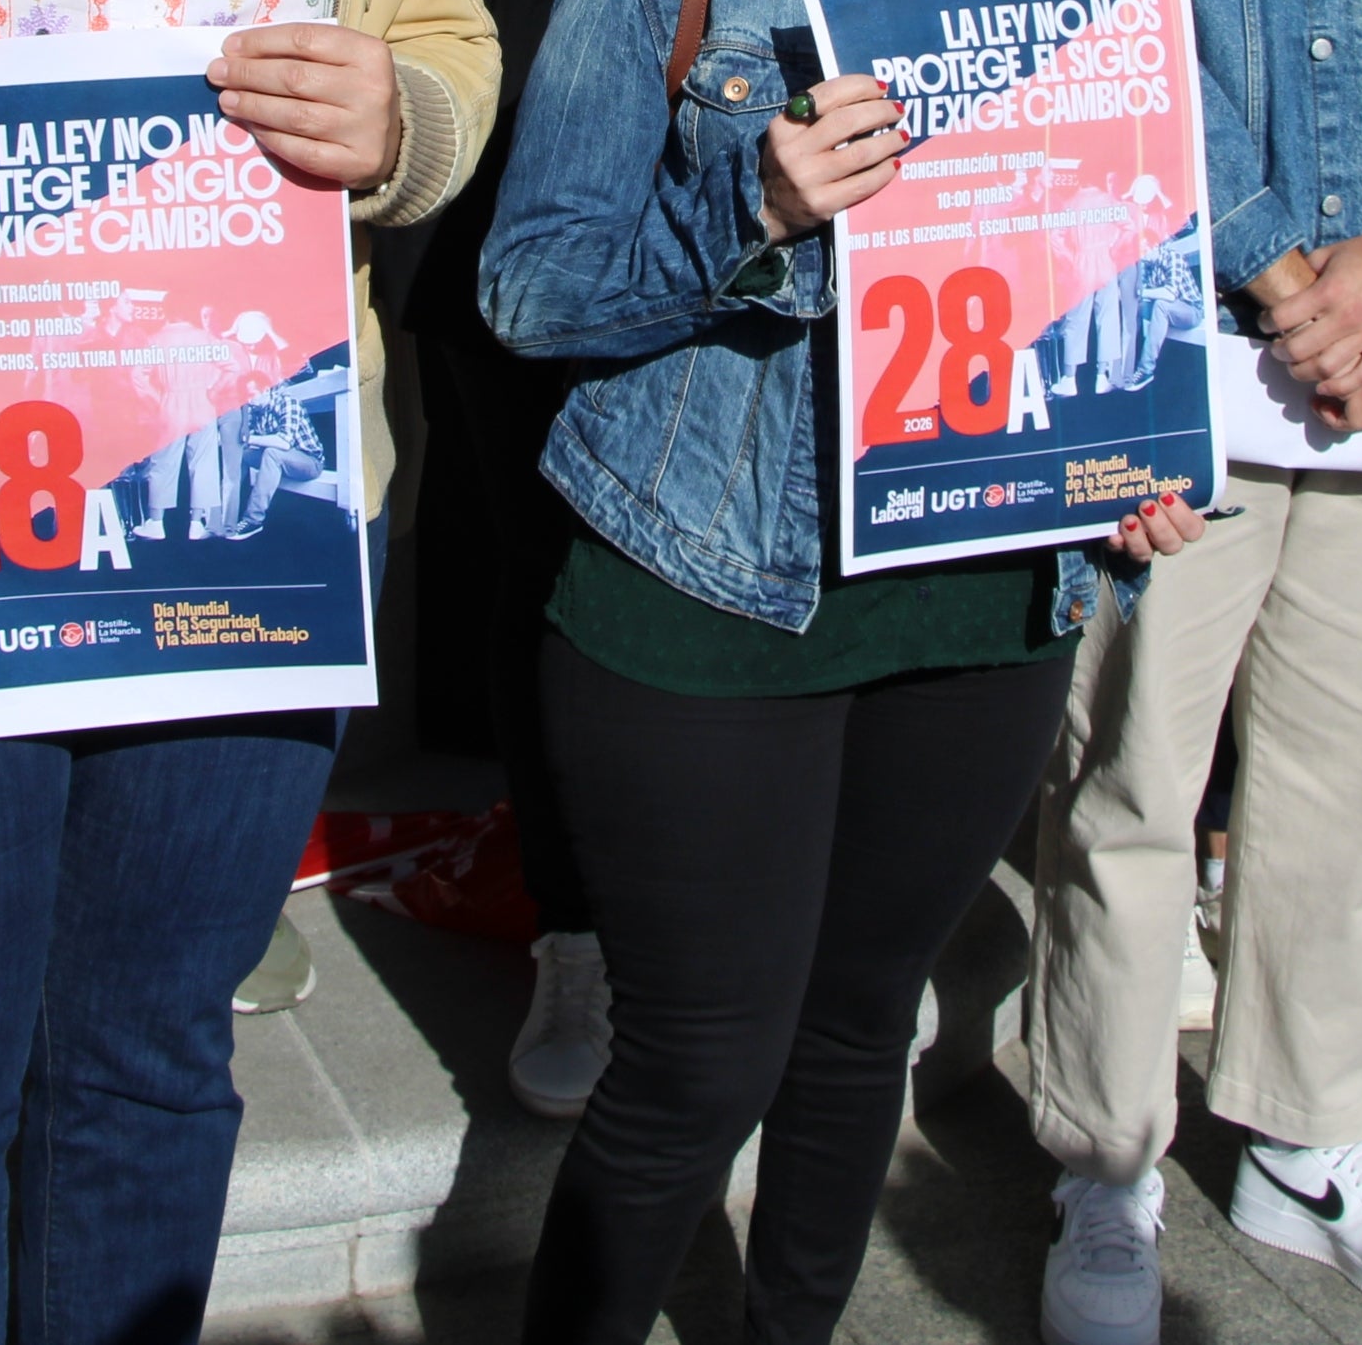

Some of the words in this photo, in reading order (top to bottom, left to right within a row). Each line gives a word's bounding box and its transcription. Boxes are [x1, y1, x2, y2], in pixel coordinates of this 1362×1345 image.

[940, 9, 979, 49] LA
[980, 4, 1028, 46] LEY
[1033, 0, 1087, 42] NO
[1034, 45, 1063, 83] EL
[1067, 35, 1166, 79] SIGLO
[883, 99, 922, 138] XI
[928, 90, 1019, 137] EXIGE
[1023, 75, 1171, 126] CAMBIOS
[47, 117, 106, 165] LEY
[113, 115, 183, 162] NO
[189, 113, 256, 154] NO
[901, 152, 1000, 181] CONCENTRACIÓN
[1002, 151, 1045, 170] TOLEDO
[106, 165, 146, 208] EL
[152, 157, 283, 204] SIGLO
[936, 189, 971, 210] 10:00
[974, 185, 1013, 207] HORAS
[91, 202, 285, 253] CAMBIOS
[849, 236, 870, 251] RNO
[873, 233, 887, 248] DE
[890, 230, 910, 247] LOS
[913, 223, 976, 244] BIZCOCHOS,
[979, 216, 1038, 236] ESCULTURA
[1041, 209, 1077, 231] MARÍA
[1080, 206, 1128, 225] PACHECO
[67, 280, 120, 302] TOLEDO
[35, 317, 83, 336] HORAS
[43, 350, 117, 370] ESCULTURA
[120, 344, 165, 367] MARÍA
[169, 344, 230, 364] PACHECO
[904, 417, 933, 433] 2026
[1066, 461, 1084, 477] Día
[1085, 455, 1128, 474] Mundial
[1066, 477, 1081, 491] de
[1083, 475, 1094, 489] la
[1095, 465, 1152, 488] Seguridad
[887, 486, 924, 508] Salud
[931, 487, 981, 513] UGT
[1027, 485, 1054, 496] Mancha
[1065, 494, 1073, 507] y
[1074, 490, 1085, 504] la
[1086, 484, 1118, 502] Salud
[1119, 485, 1135, 499] en
[1136, 481, 1148, 497] el
[1149, 474, 1193, 495] Trabajo
[871, 501, 924, 525] Laboral
[153, 602, 175, 618] Día
[177, 601, 229, 616] Mundial
[97, 619, 132, 630] Castilla-
[98, 628, 109, 636] La
[110, 626, 142, 636] Mancha
[155, 617, 172, 633] de
[174, 617, 188, 632] la
[190, 614, 260, 633] Seguridad
[156, 634, 165, 650] y
[166, 632, 179, 646] la
[181, 629, 217, 645] Salud
[219, 632, 238, 644] en
[240, 628, 255, 643] el
[258, 626, 309, 644] Trabajo
